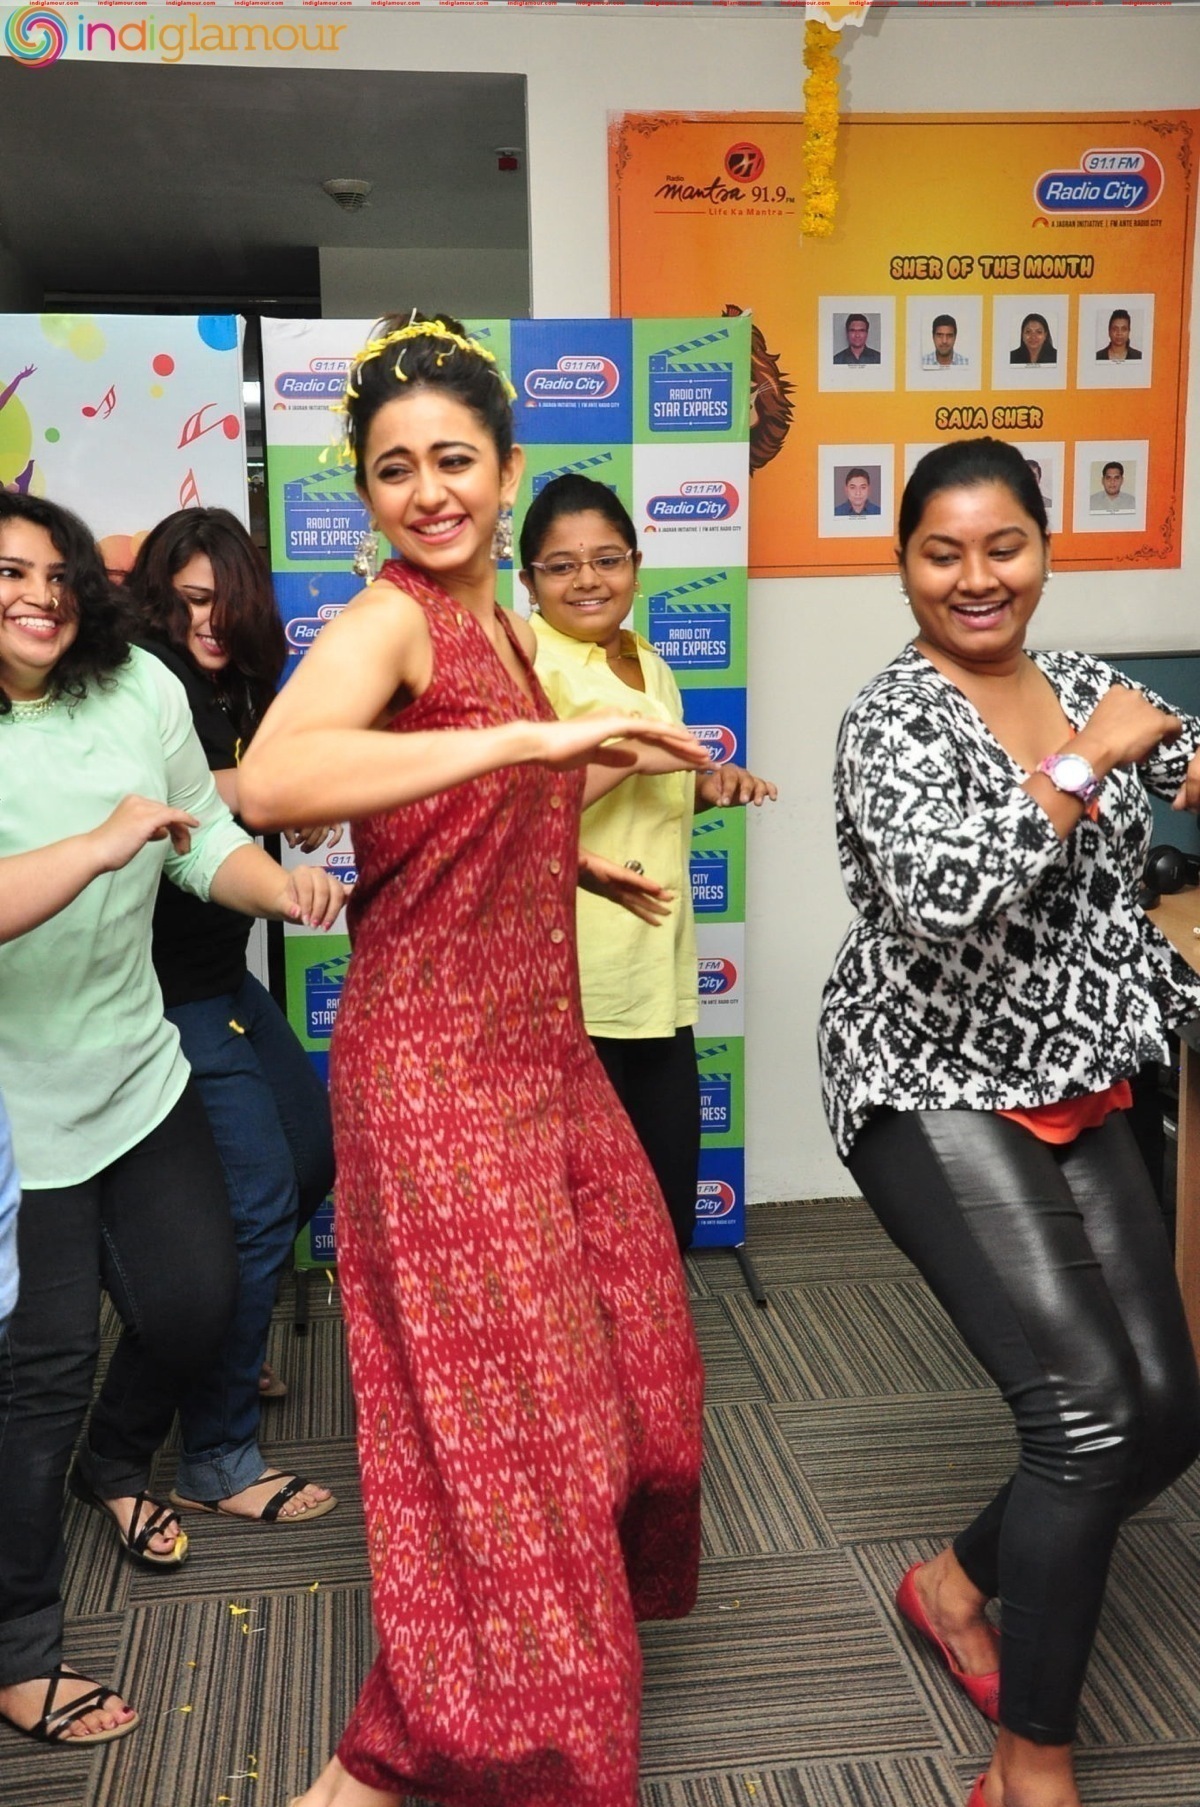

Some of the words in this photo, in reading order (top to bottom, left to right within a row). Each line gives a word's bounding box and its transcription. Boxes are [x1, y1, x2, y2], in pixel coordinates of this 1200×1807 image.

[1089, 157, 1117, 169] 91.1
[1118, 157, 1140, 169] FM
[751, 186, 786, 203] 91.9
[1046, 181, 1101, 200] Radio
[1103, 181, 1143, 208] City
[890, 256, 943, 280] SHER
[947, 255, 974, 280] OF
[978, 255, 1022, 280] THE
[1023, 254, 1095, 279] MONTH
[315, 361, 338, 371] 91.1
[564, 362, 586, 370] 91.1
[585, 361, 601, 370] FM
[282, 378, 326, 392] Radio
[533, 377, 574, 390] Radio
[575, 377, 605, 396] City
[669, 388, 694, 401] RADIO
[695, 387, 712, 400] CITY
[653, 401, 681, 418] STAR
[683, 400, 729, 417] EXPRESS
[991, 405, 1044, 429] SHER
[706, 485, 722, 493] FM
[653, 501, 695, 515] Radio
[696, 501, 726, 520] City
[306, 517, 332, 530] RADIO
[333, 517, 351, 529] CITY
[290, 531, 319, 546] STAR
[669, 629, 693, 640] RADIO
[694, 628, 711, 640] CITY
[682, 640, 727, 656] EXPRESS
[704, 730, 720, 738] FM
[331, 856, 352, 865] 91.1
[692, 874, 709, 885] CITY
[692, 885, 725, 900] PRESS
[704, 961, 721, 970] FM
[697, 976, 725, 994] City
[695, 1198, 723, 1215] City
